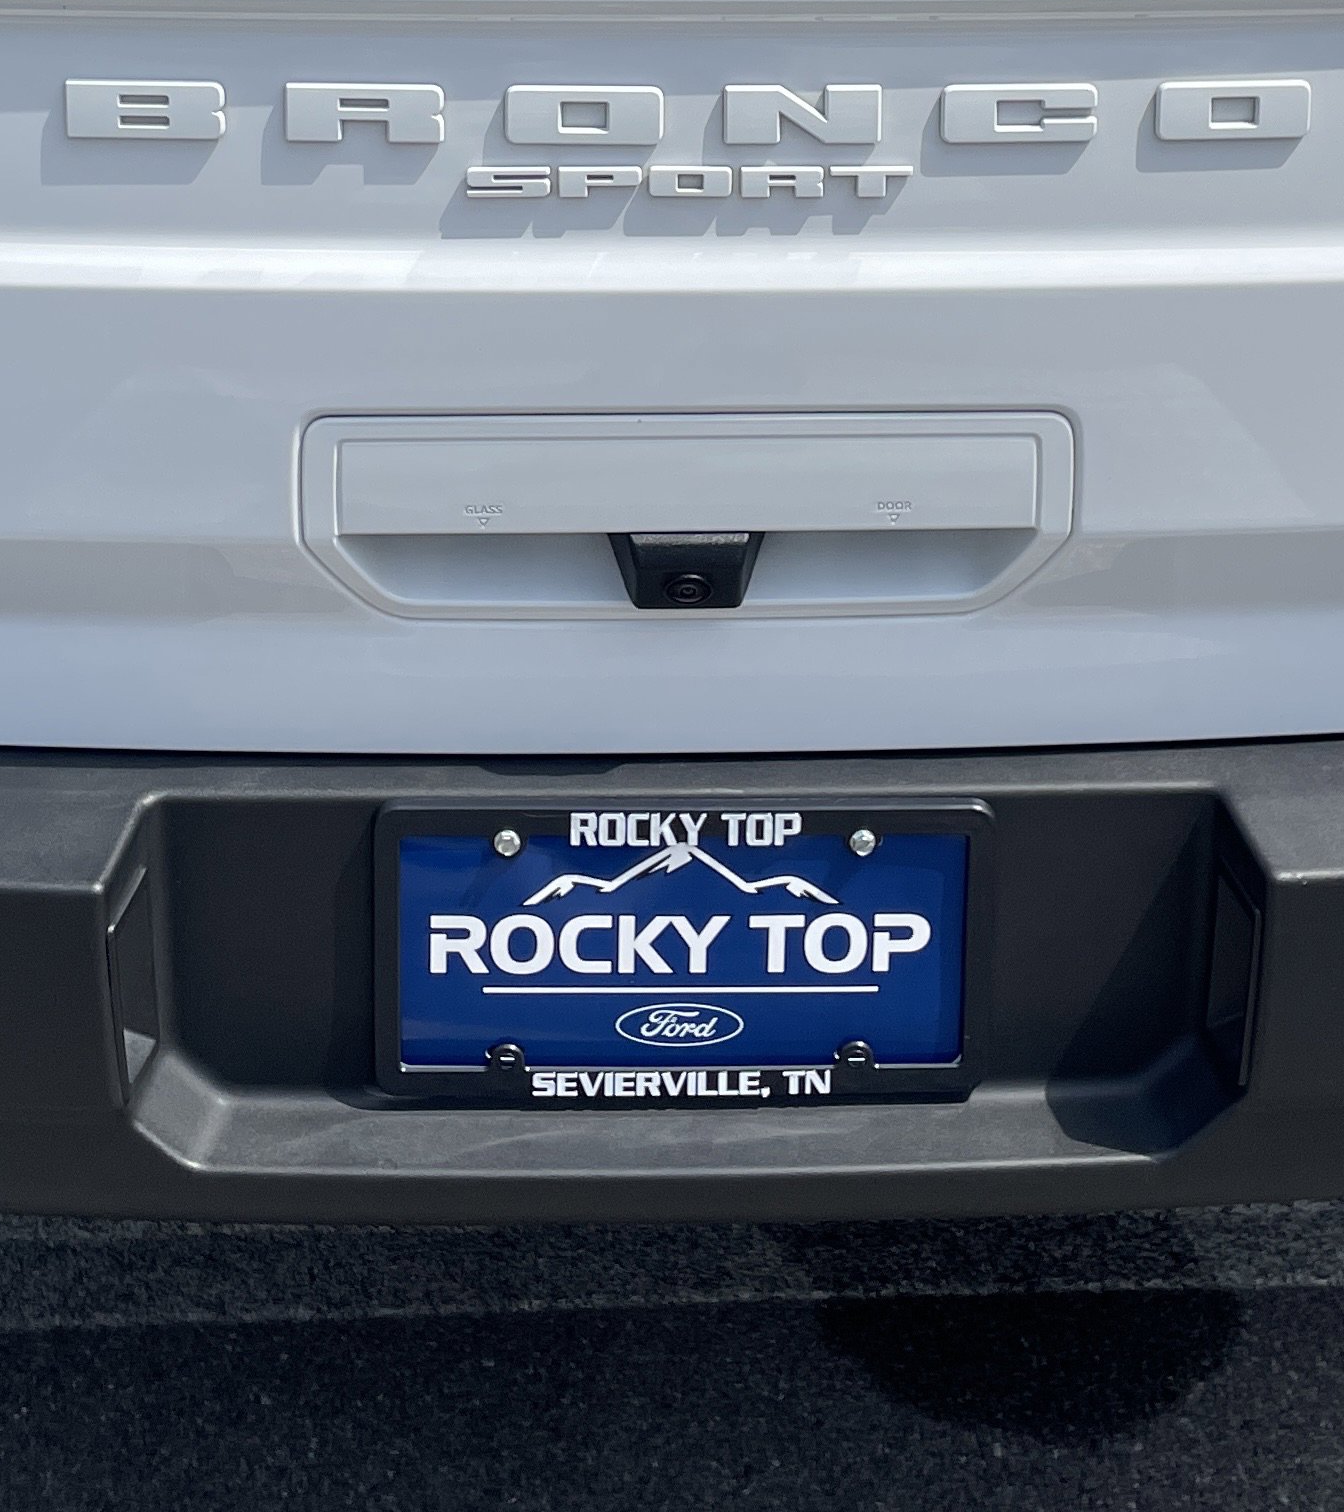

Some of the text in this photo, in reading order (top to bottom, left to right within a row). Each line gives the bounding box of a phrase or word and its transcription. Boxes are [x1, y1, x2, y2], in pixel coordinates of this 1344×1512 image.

[65, 79, 1311, 145] BRONCO
[465, 164, 913, 199] SPORT
[464, 504, 503, 515] GLASS
[877, 500, 912, 511] DOOR
[570, 812, 801, 847] ROCKY TOP
[428, 913, 932, 975] ROCKY TOP
[640, 1009, 717, 1039] Ford
[532, 1070, 831, 1098] SEVIERVILLE, TN
